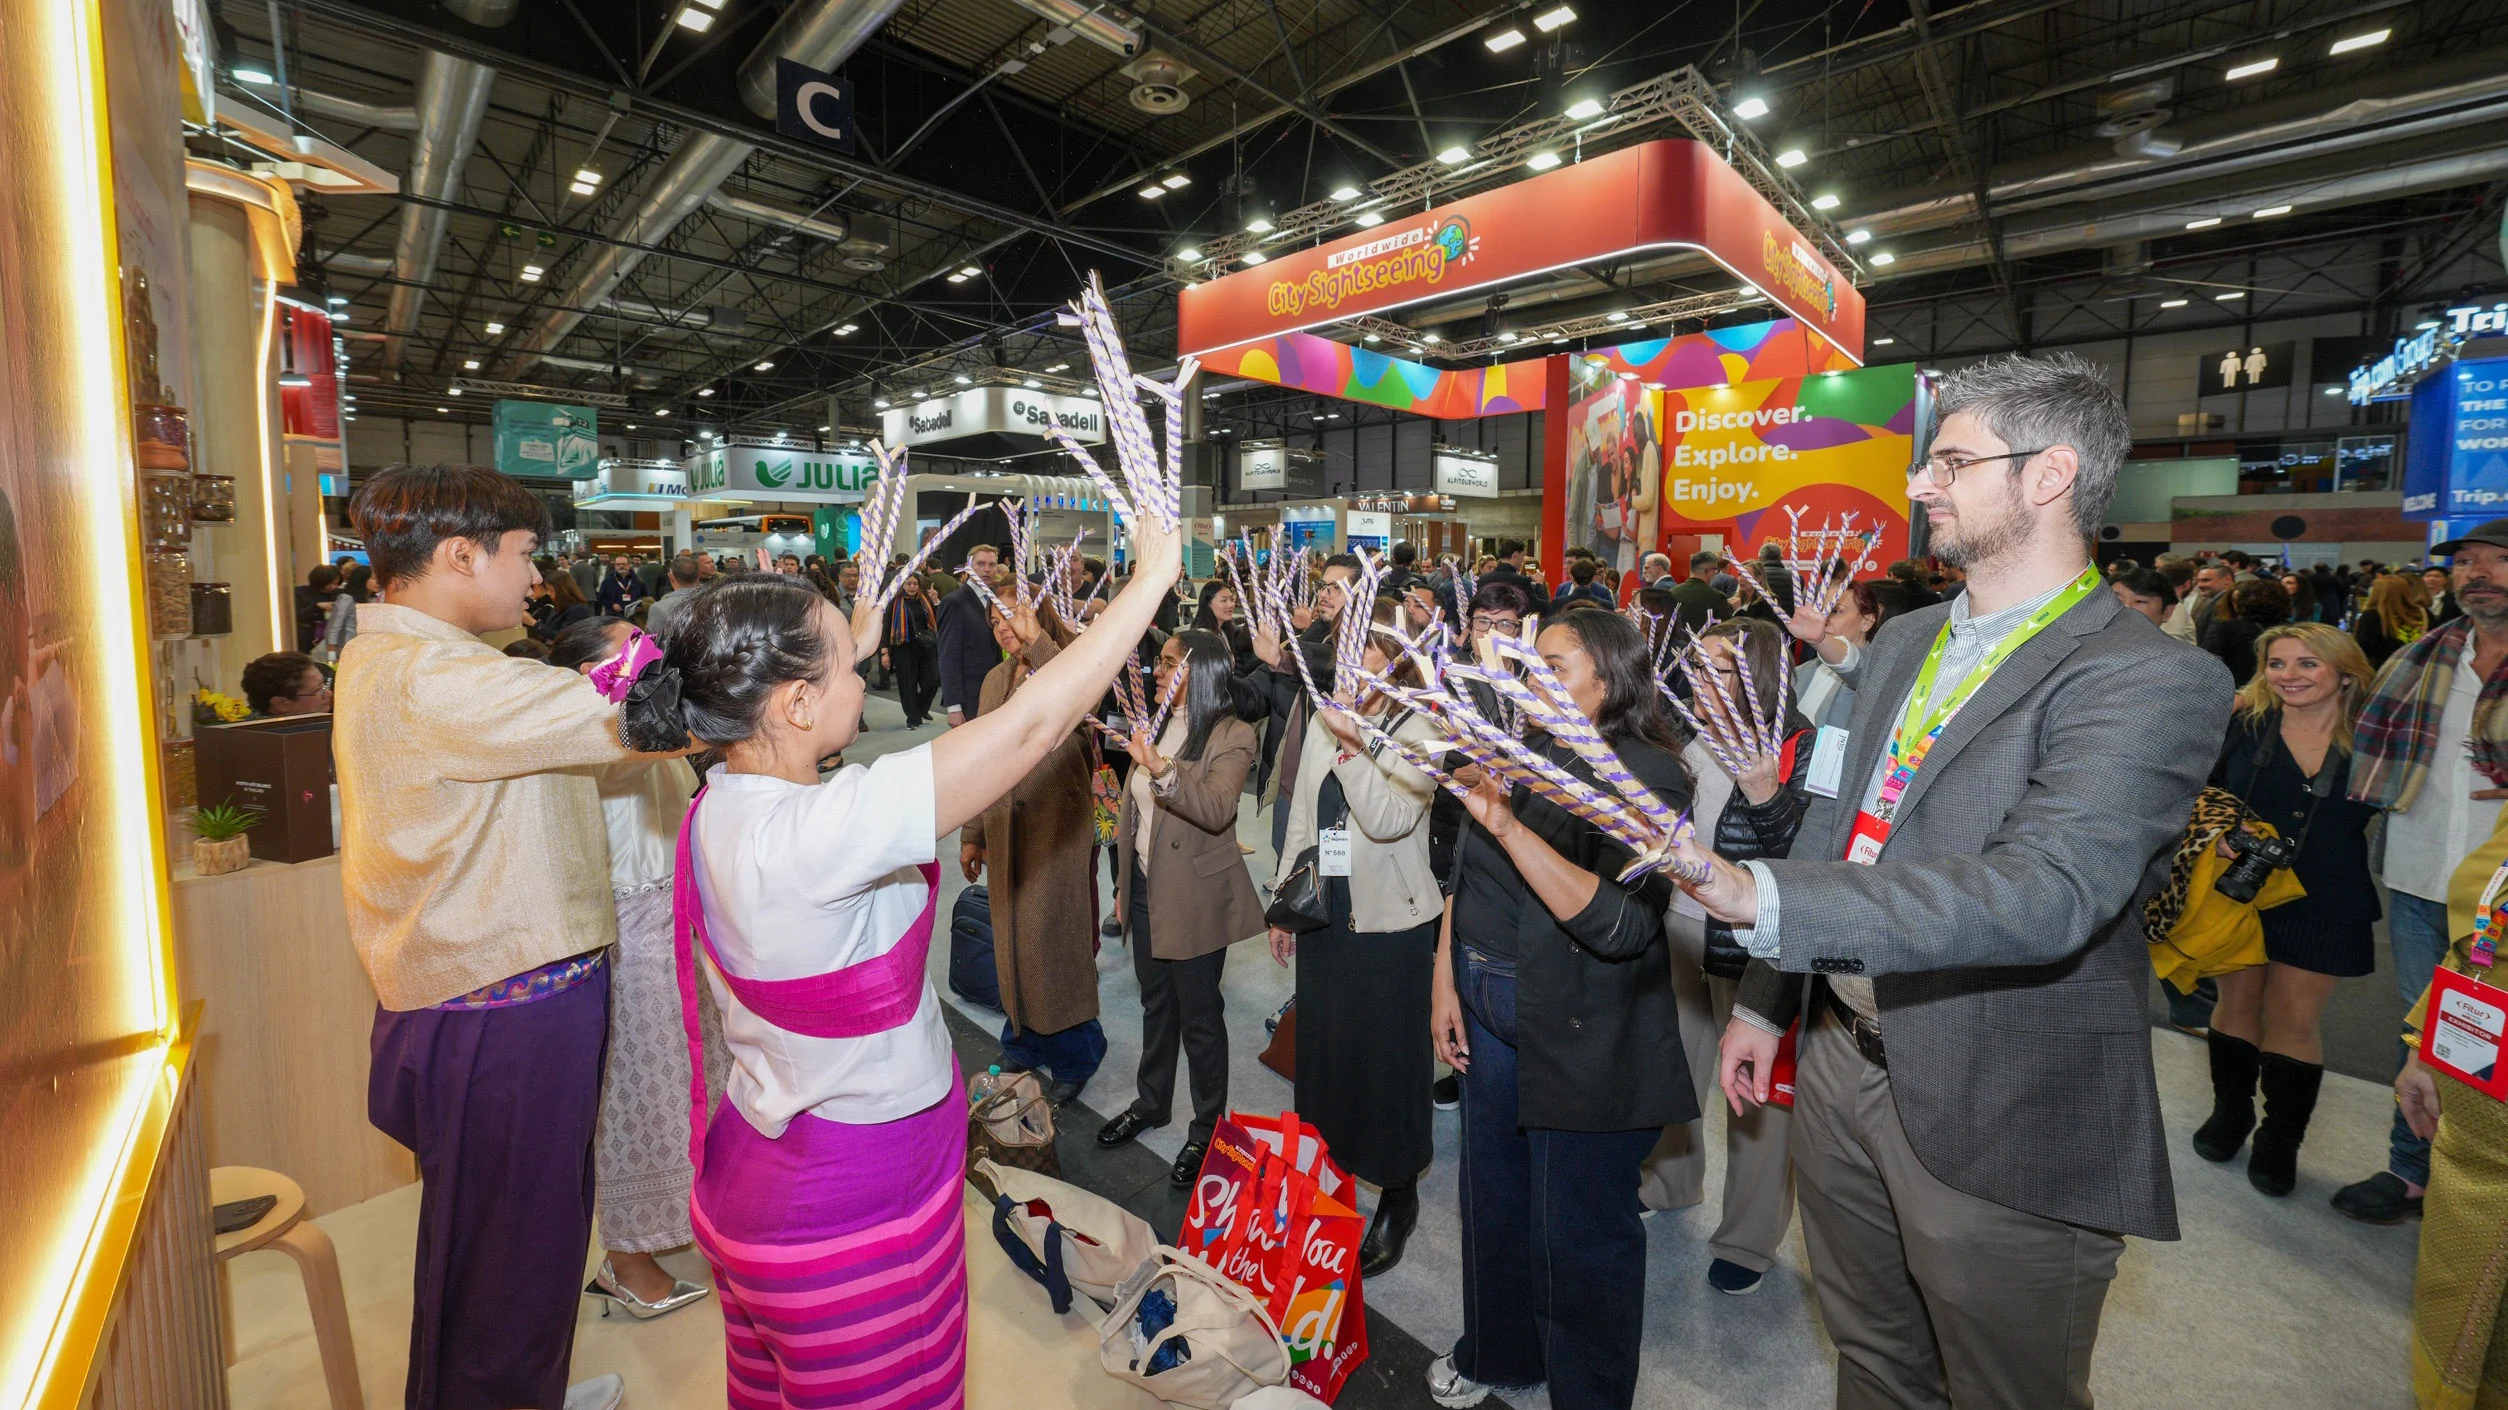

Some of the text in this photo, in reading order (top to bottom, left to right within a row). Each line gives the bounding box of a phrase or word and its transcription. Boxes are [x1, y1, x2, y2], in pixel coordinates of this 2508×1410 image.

[796, 81, 841, 140] C
[1334, 231, 1420, 264] Worldwide
[2446, 303, 2508, 335] Tri
[914, 409, 953, 434] Sabadell
[1675, 405, 1813, 433] Discover.
[1674, 441, 1799, 470] Explore.
[1673, 476, 1760, 505] Enjoy.
[2037, 611, 2050, 623] aena
[1837, 733, 1847, 751] JNTO
